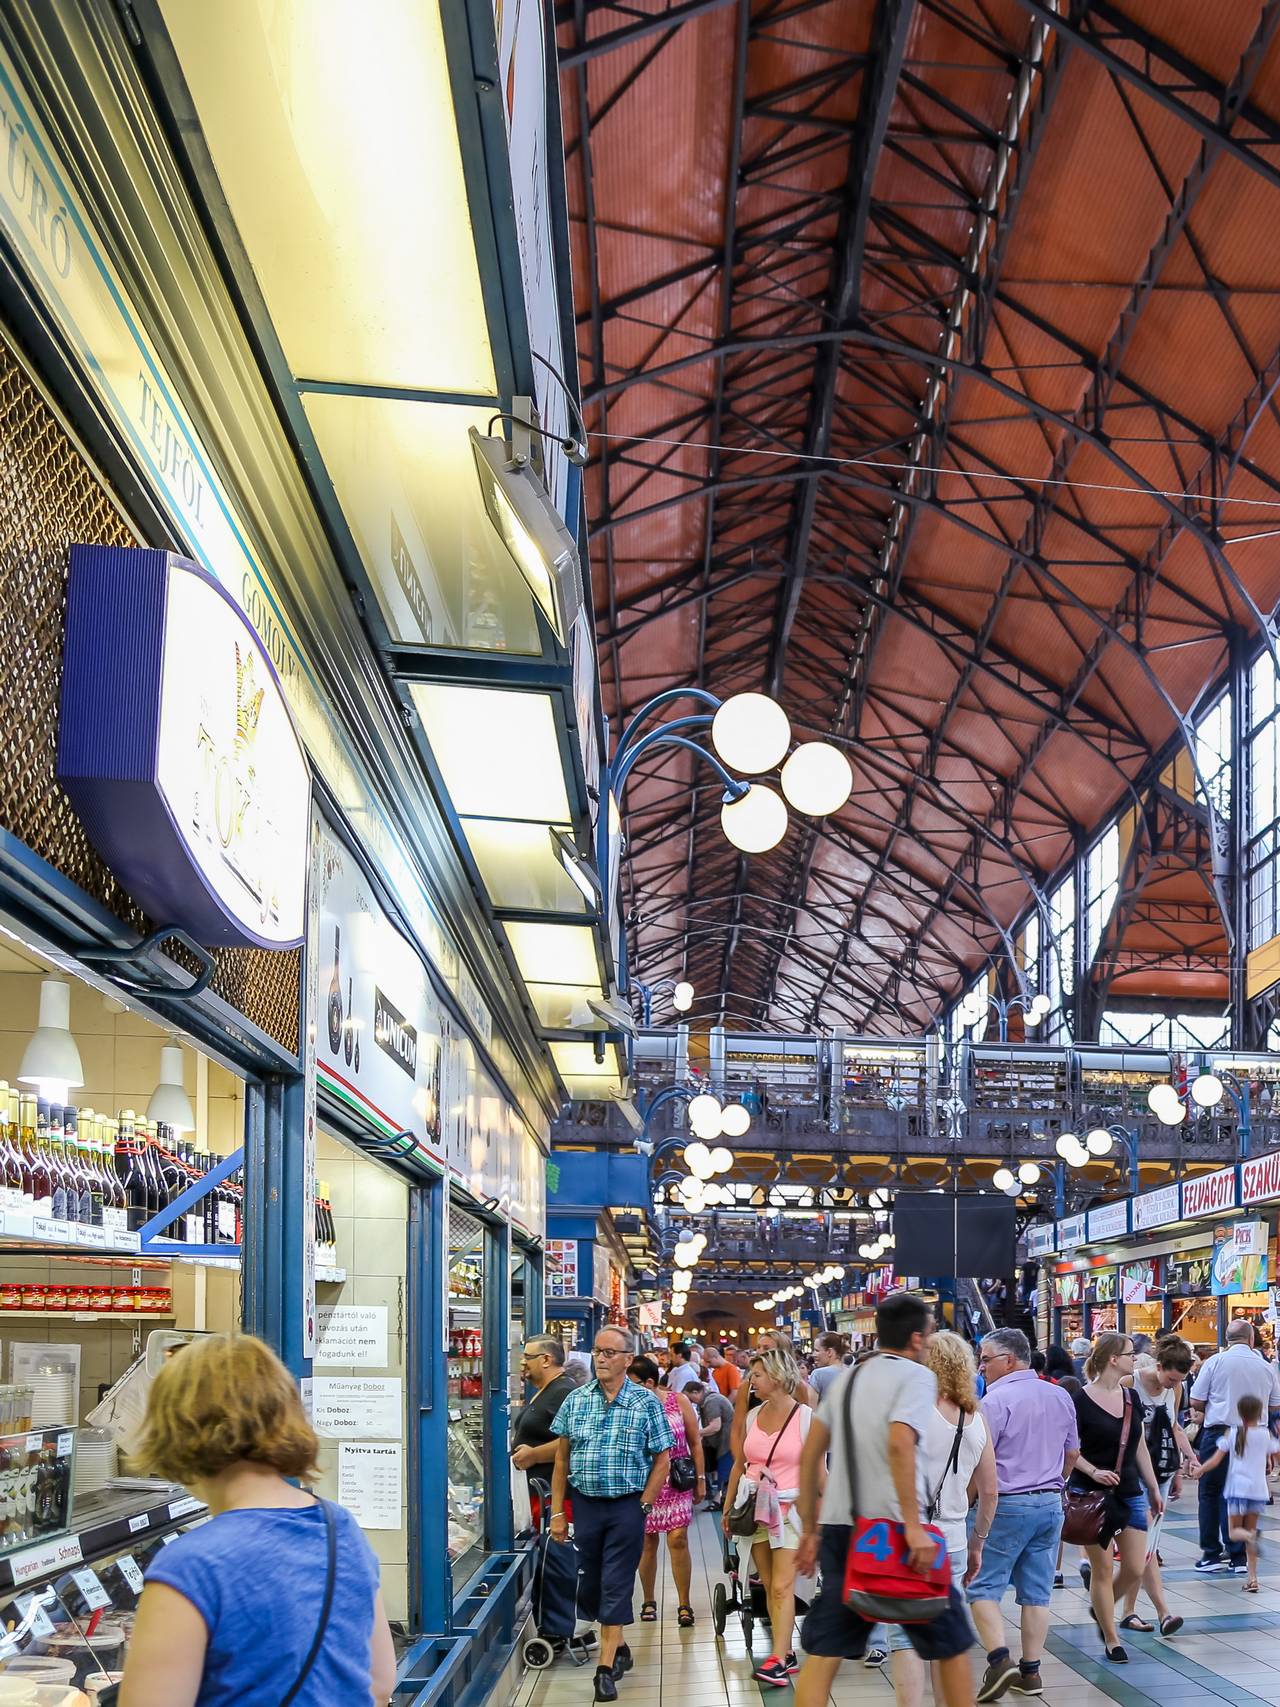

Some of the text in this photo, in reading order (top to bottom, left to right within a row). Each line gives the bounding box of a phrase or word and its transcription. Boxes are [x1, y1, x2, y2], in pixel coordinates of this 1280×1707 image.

[383, 1010, 416, 1069] UNICUM
[1184, 1172, 1236, 1214] FELVÁGOTT
[363, 1383, 385, 1391] Doboz
[344, 1446, 371, 1454] Nyitva
[15, 1561, 39, 1576] Hungarian
[58, 1544, 81, 1561] Schnaps
